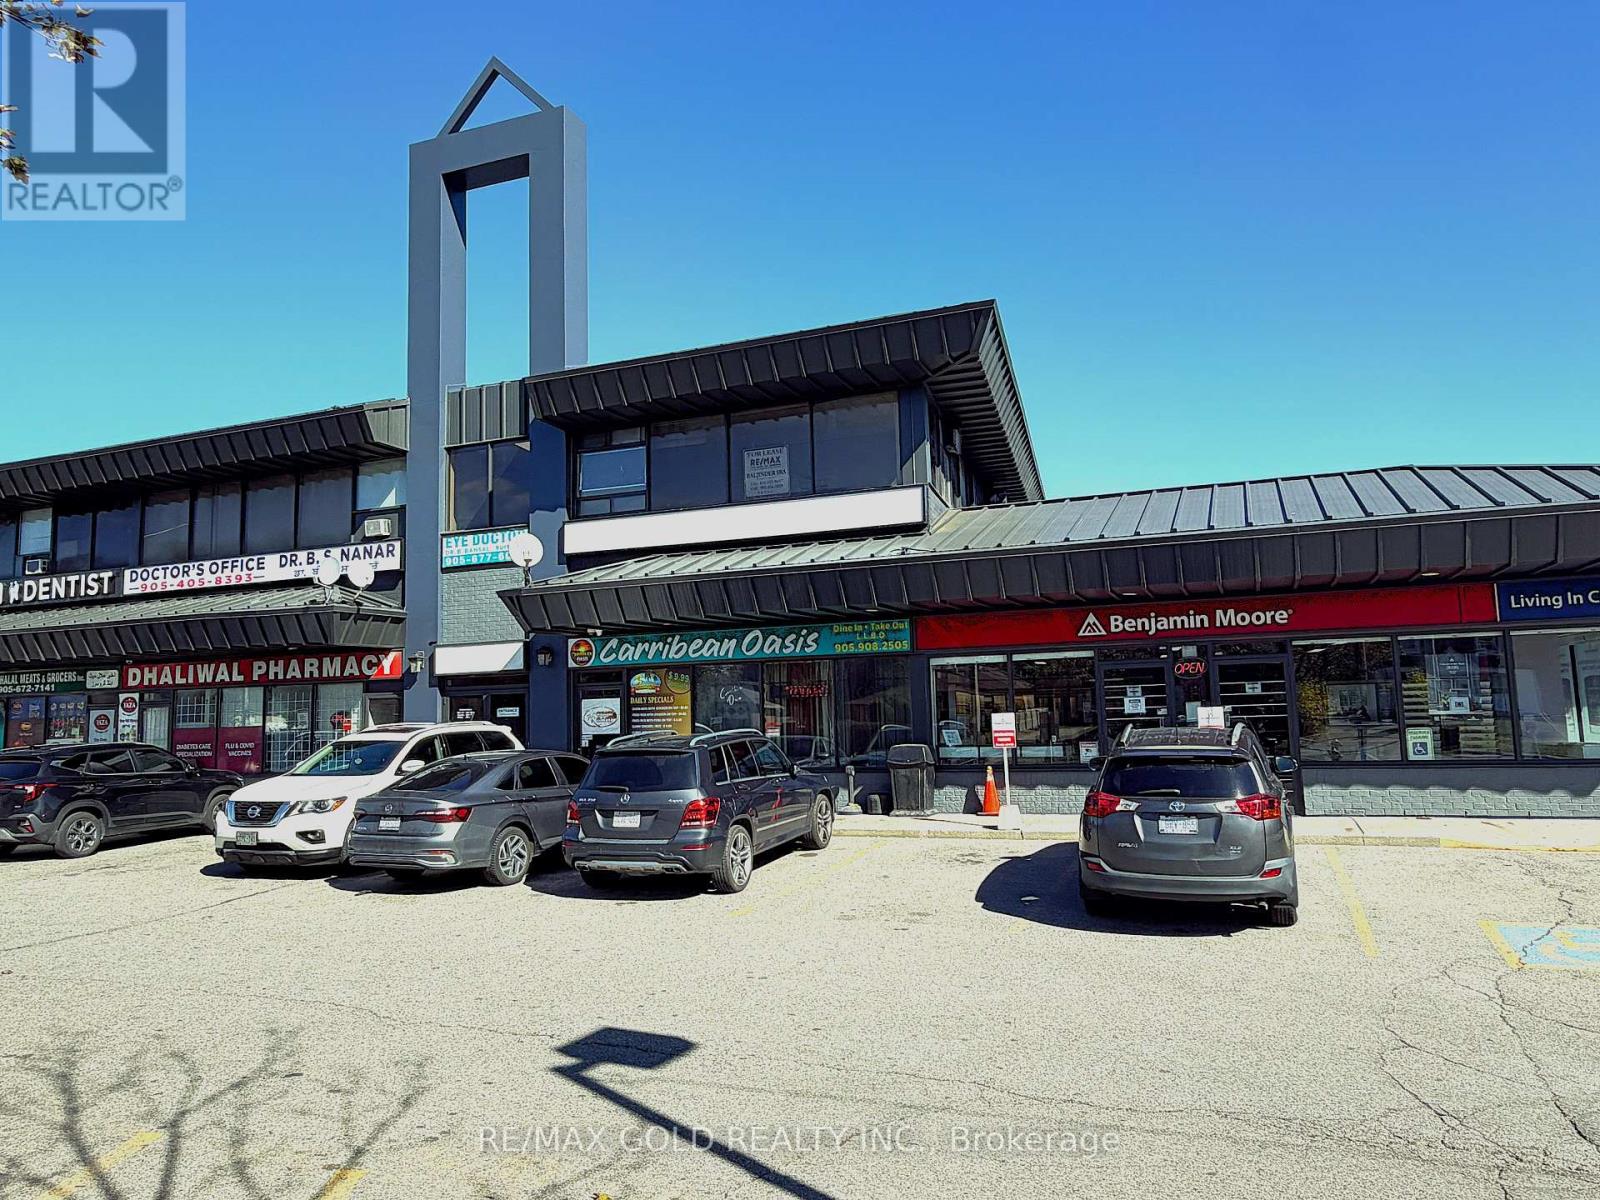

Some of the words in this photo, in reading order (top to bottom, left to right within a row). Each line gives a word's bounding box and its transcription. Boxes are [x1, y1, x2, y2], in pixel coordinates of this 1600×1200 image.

[750, 456, 781, 466] RE/MAX
[446, 535, 468, 548] EYE
[473, 530, 527, 545] DOCTO
[279, 553, 302, 568] DR.
[307, 552, 319, 565] B.
[340, 543, 396, 561] NANAR
[129, 563, 205, 582] DOCTOR'S
[209, 557, 265, 575] OFFICE
[23, 571, 113, 602] DENTIST
[140, 573, 253, 592] 905-405-8393
[1510, 593, 1563, 609] Living
[1567, 591, 1584, 605] In
[870, 621, 890, 631] Take
[892, 621, 908, 630] Out
[1109, 610, 1209, 635] Benjamin
[600, 635, 737, 663] Carribean
[741, 628, 820, 656] Oasis
[834, 640, 909, 653] 905.908.2505
[127, 661, 245, 687] DHALIWAL
[252, 653, 396, 680] PHARMACY
[1174, 662, 1205, 674] OPEN
[20, 673, 40, 684] MEATS
[47, 671, 77, 682] GROCERS
[648, 695, 674, 704] SPECIALS
